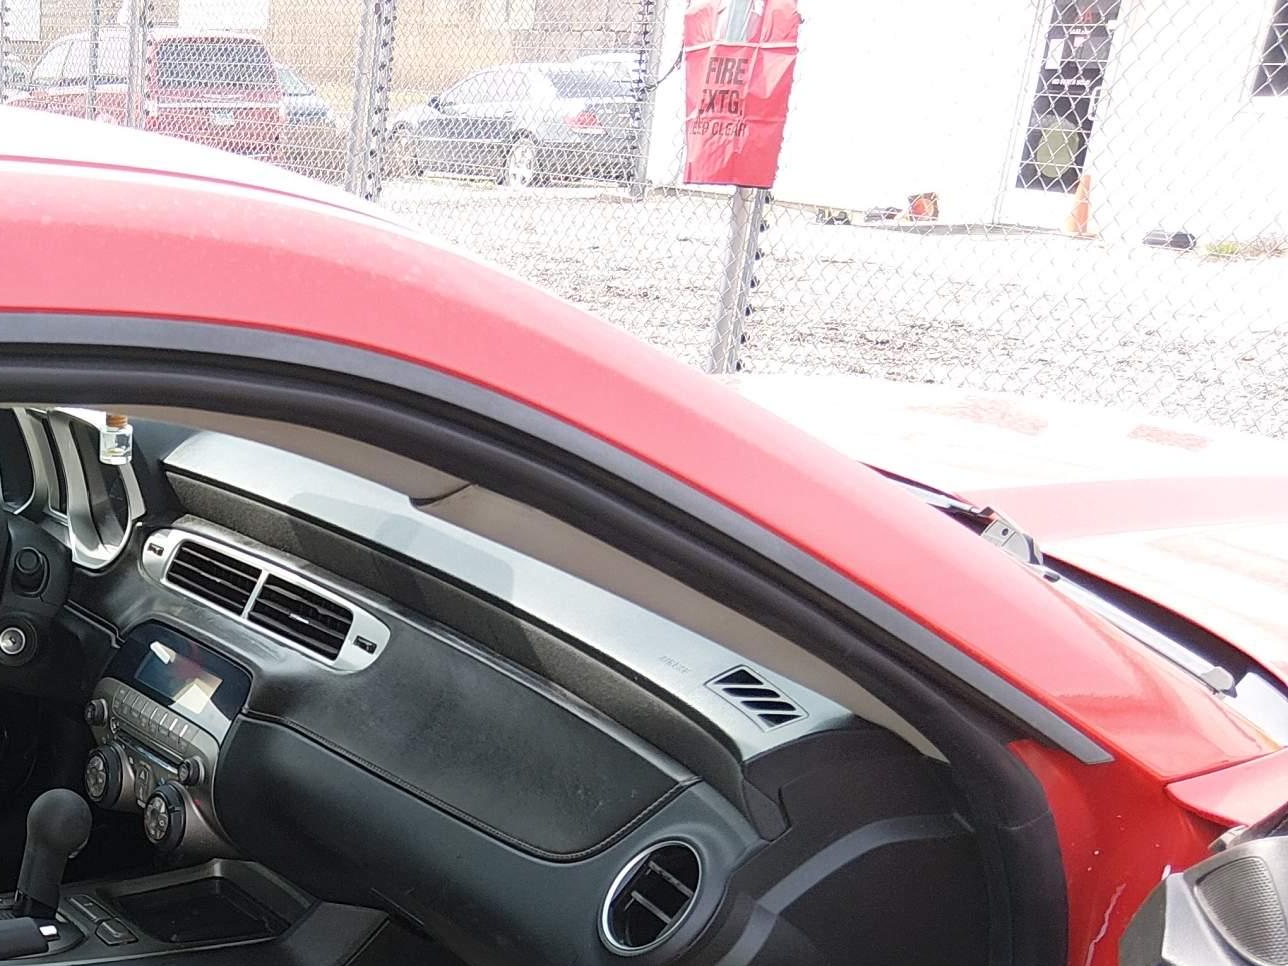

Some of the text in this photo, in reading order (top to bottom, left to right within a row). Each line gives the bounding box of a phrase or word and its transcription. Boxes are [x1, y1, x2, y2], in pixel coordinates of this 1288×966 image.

[705, 56, 749, 86] FIRE
[690, 120, 747, 137] EEP CLEAR
